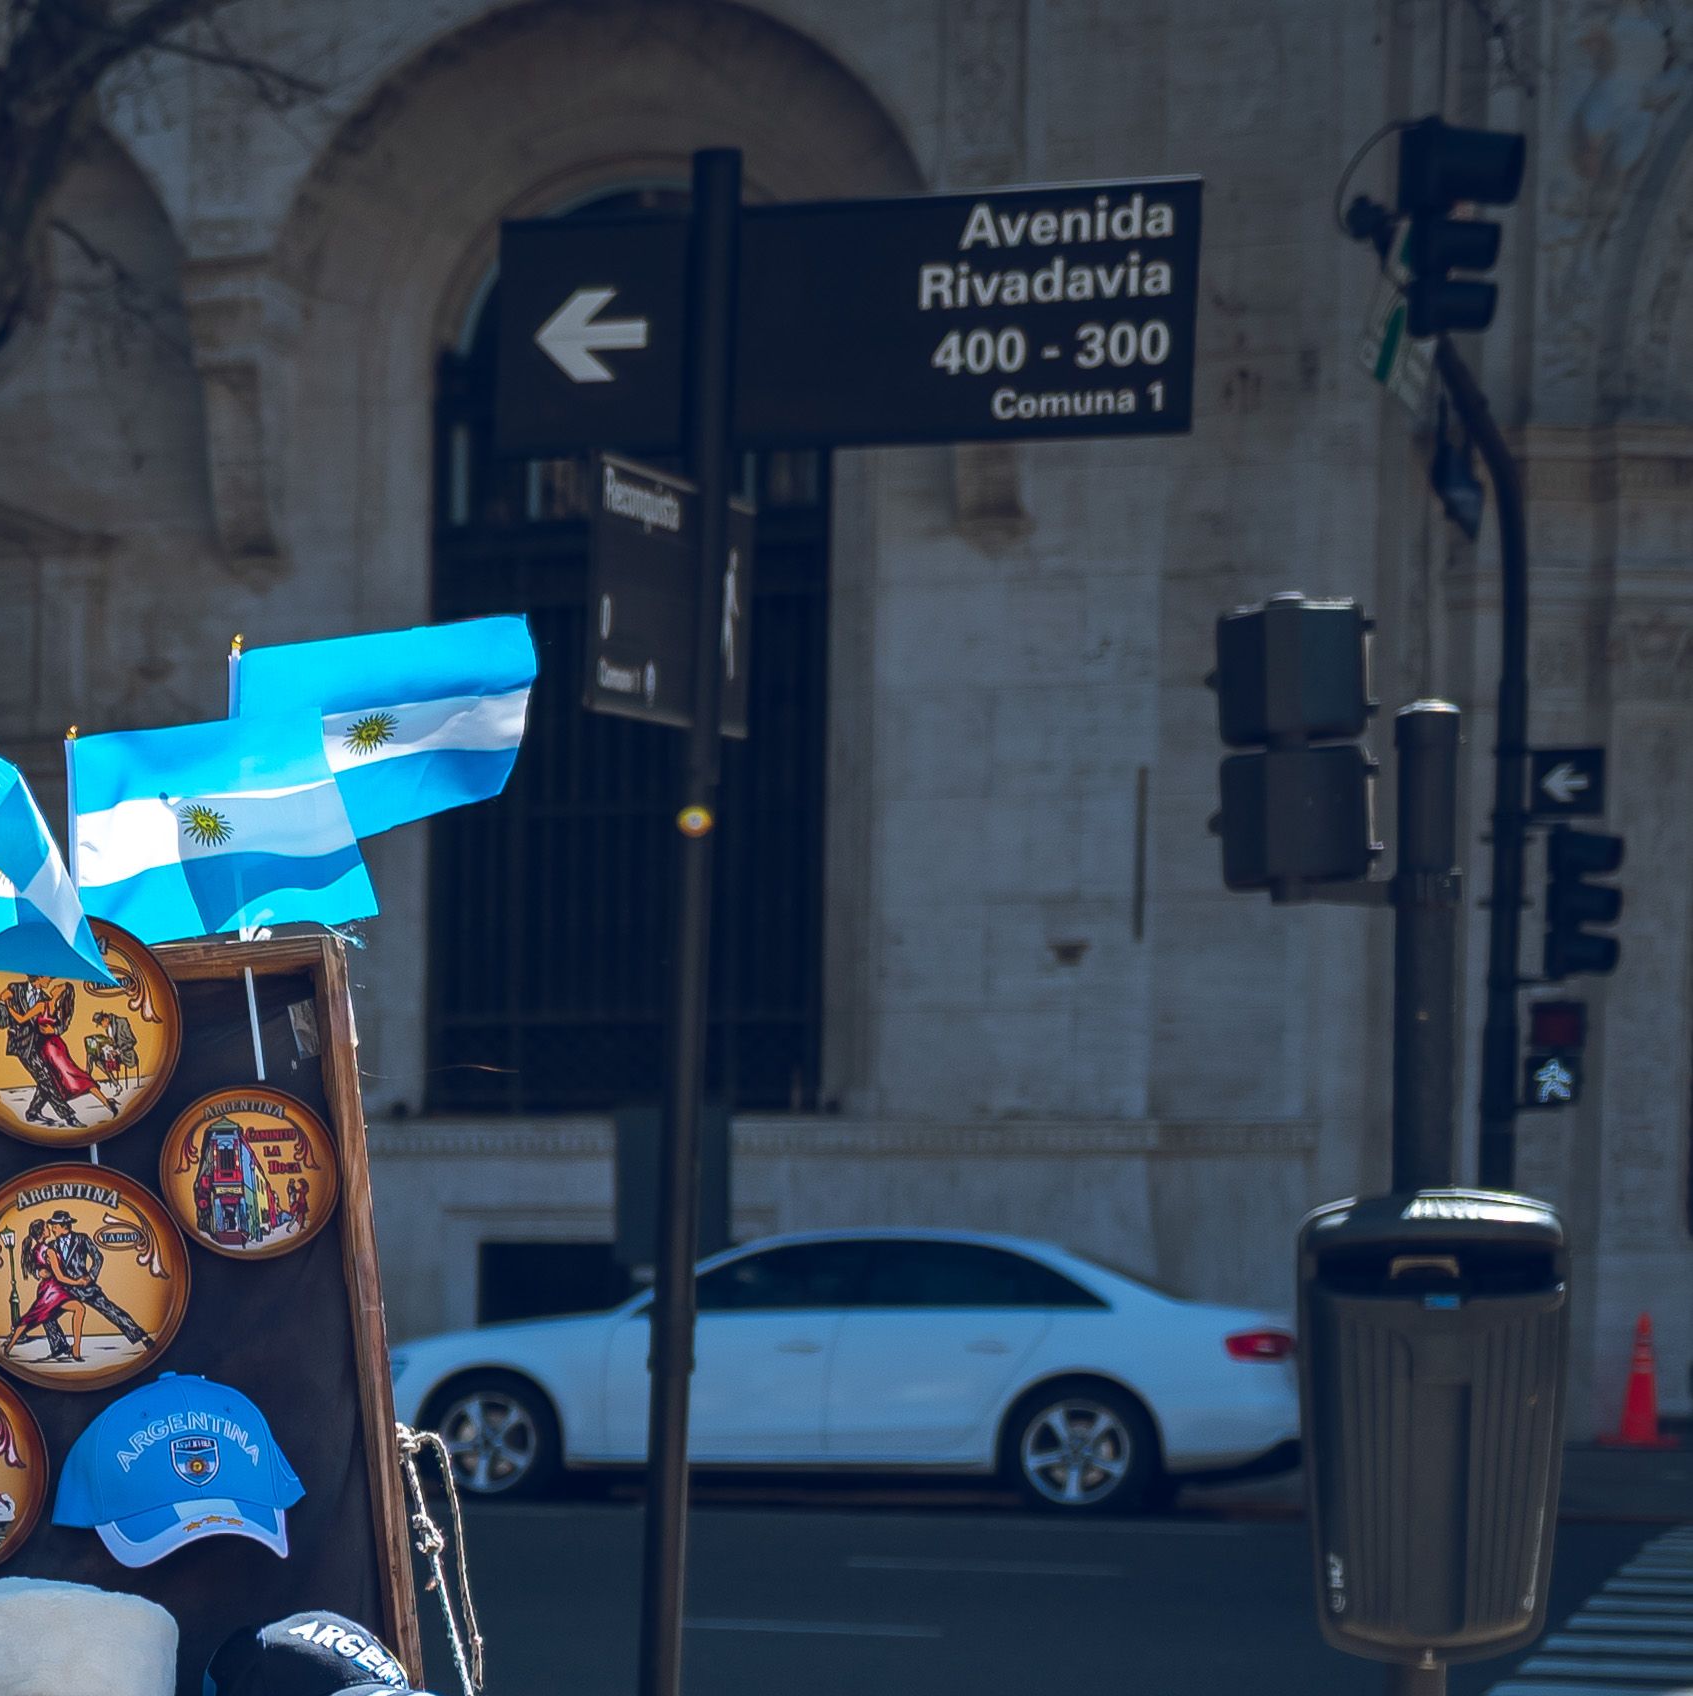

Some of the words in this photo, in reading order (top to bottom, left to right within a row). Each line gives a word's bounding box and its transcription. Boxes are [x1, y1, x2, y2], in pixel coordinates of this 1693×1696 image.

[959, 193, 1174, 250] Avenida
[918, 250, 1172, 310] Rivadavia
[931, 326, 1027, 375] 400
[1040, 344, 1061, 360] -
[1074, 319, 1170, 369] 300
[991, 387, 1136, 420] Comuna
[1146, 377, 1165, 412] 1
[204, 1100, 285, 1119] ARGENTINA
[263, 1145, 281, 1157] LA
[268, 1161, 301, 1174] BOCA
[17, 1183, 119, 1211] ARGENTINA
[102, 1232, 139, 1243] TANGO
[116, 1411, 260, 1472] ARGENTINA
